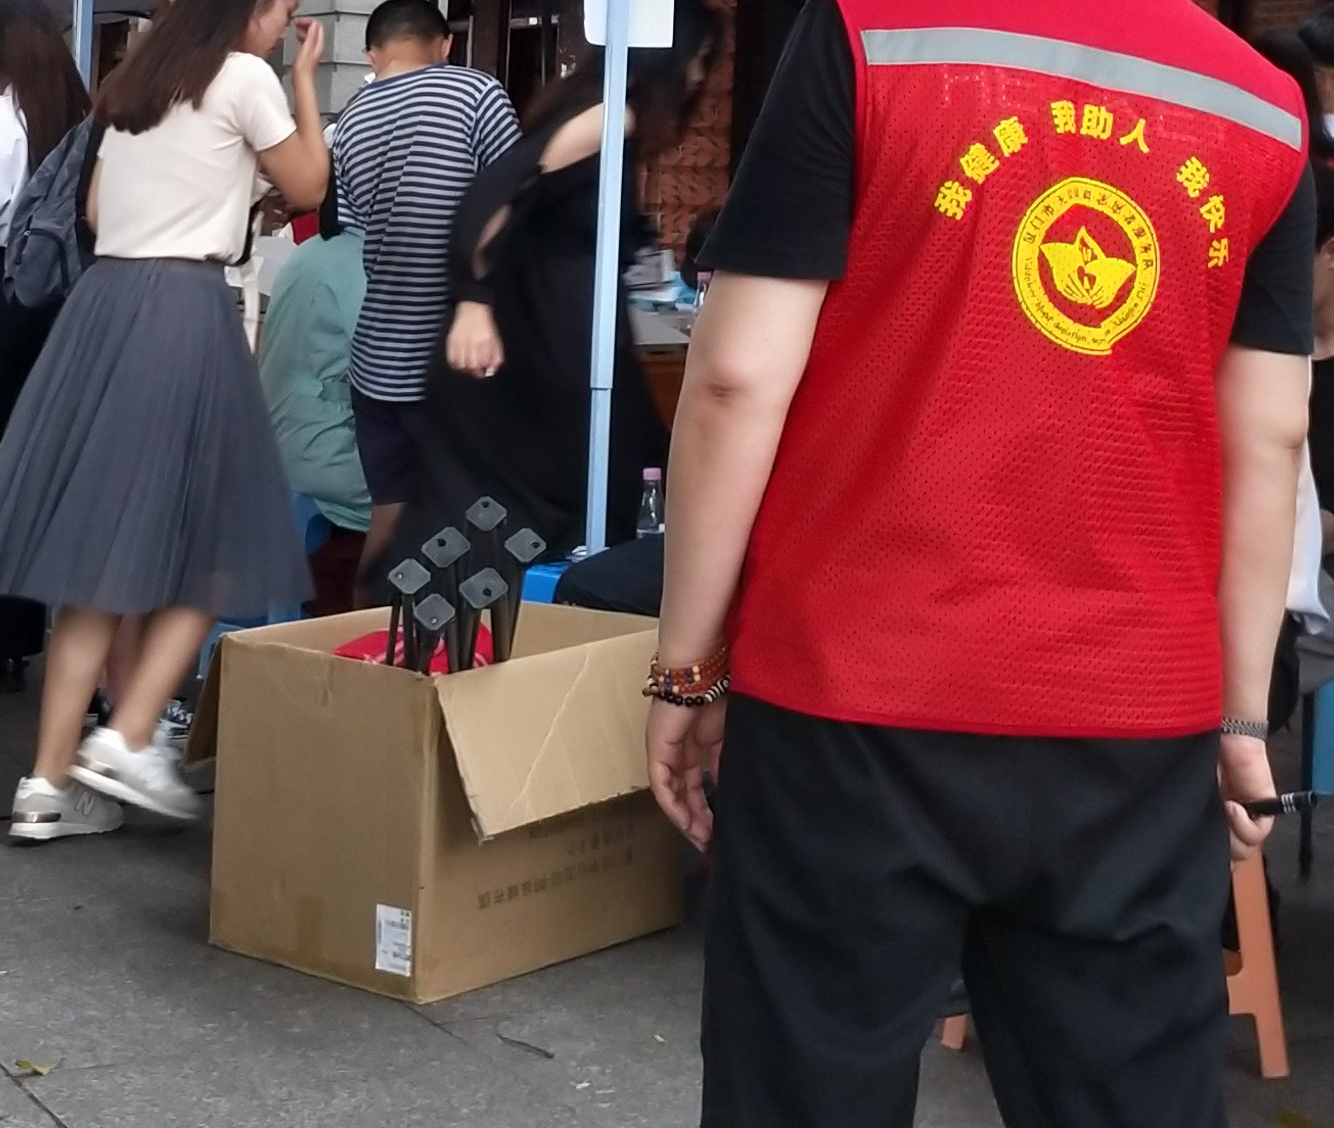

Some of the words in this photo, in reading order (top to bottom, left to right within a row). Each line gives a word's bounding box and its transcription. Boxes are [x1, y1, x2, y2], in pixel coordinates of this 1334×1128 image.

[934, 115, 1029, 221] 我健康
[1050, 100, 1150, 154] 我助人
[1176, 156, 1229, 269] 我快乐
